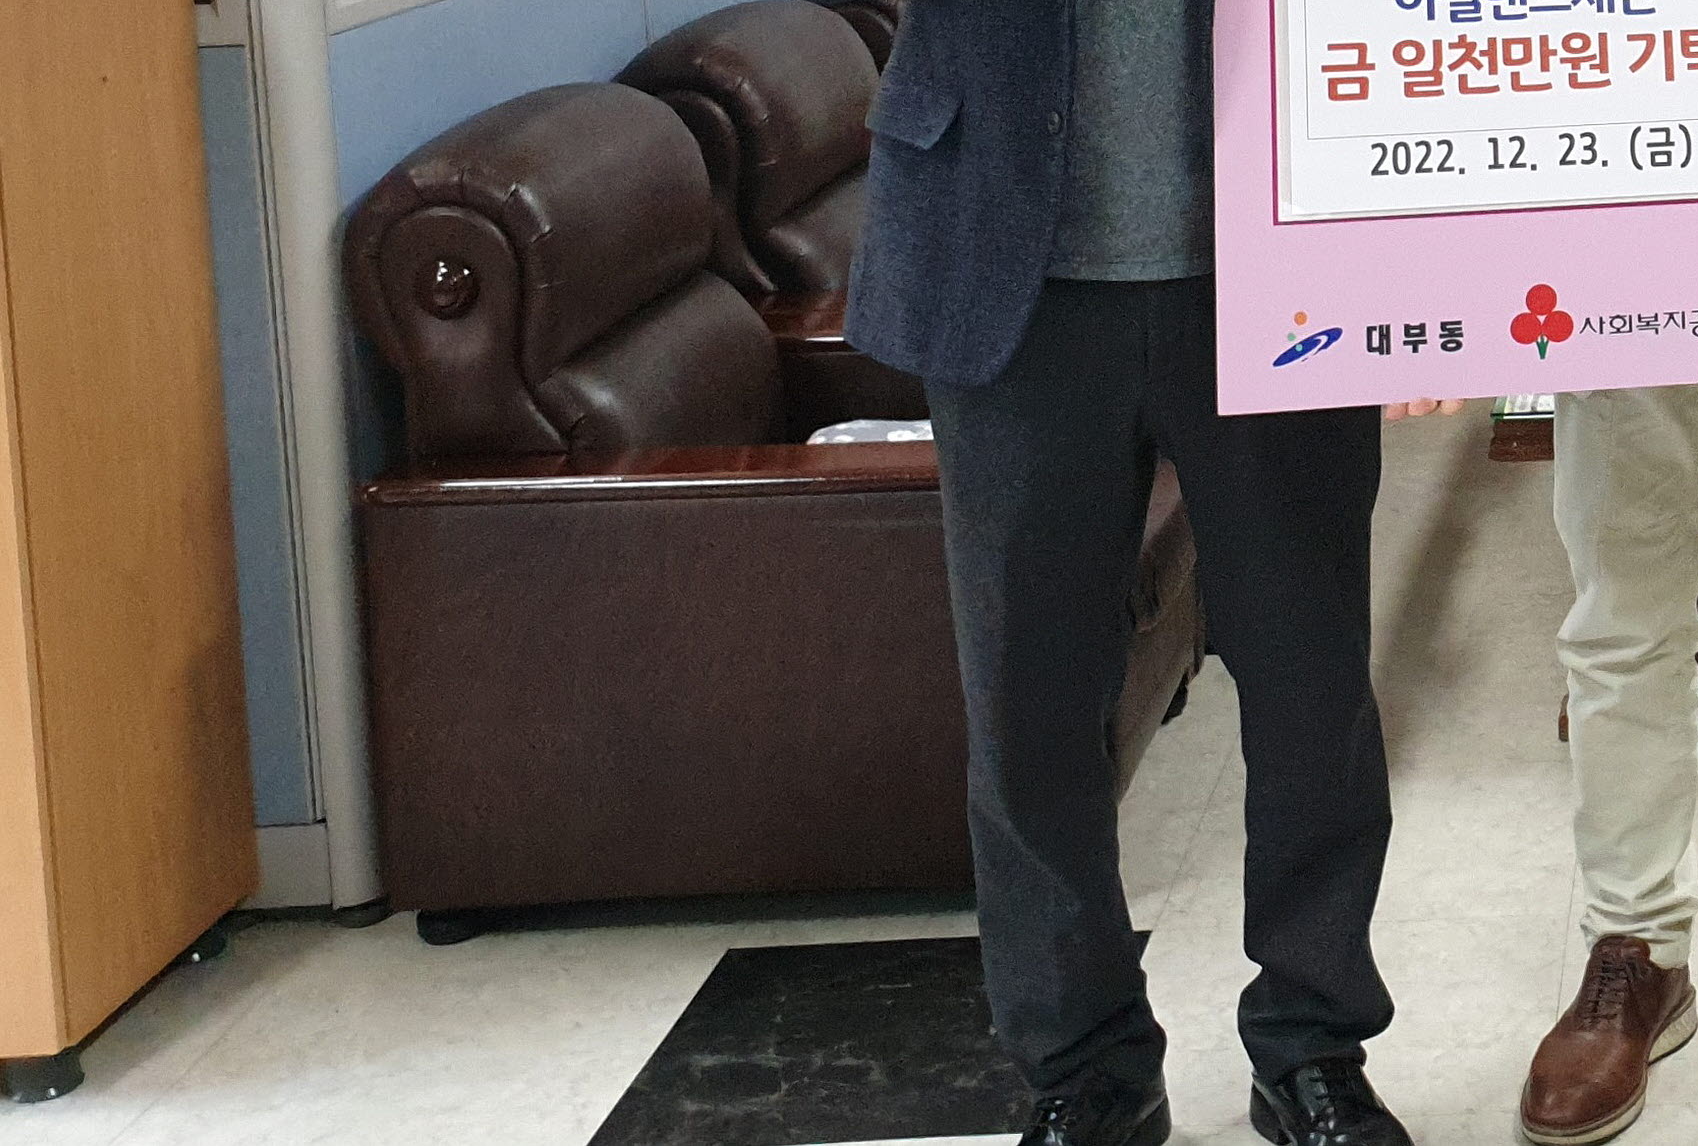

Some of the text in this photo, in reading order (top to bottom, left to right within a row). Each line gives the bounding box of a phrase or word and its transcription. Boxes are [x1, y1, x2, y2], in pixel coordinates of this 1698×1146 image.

[1320, 41, 1376, 103] 금
[1391, 32, 1612, 99] 일천만원
[1370, 123, 1694, 177] 2022. 12. 23. (금)
[1365, 319, 1466, 356] 대부동
